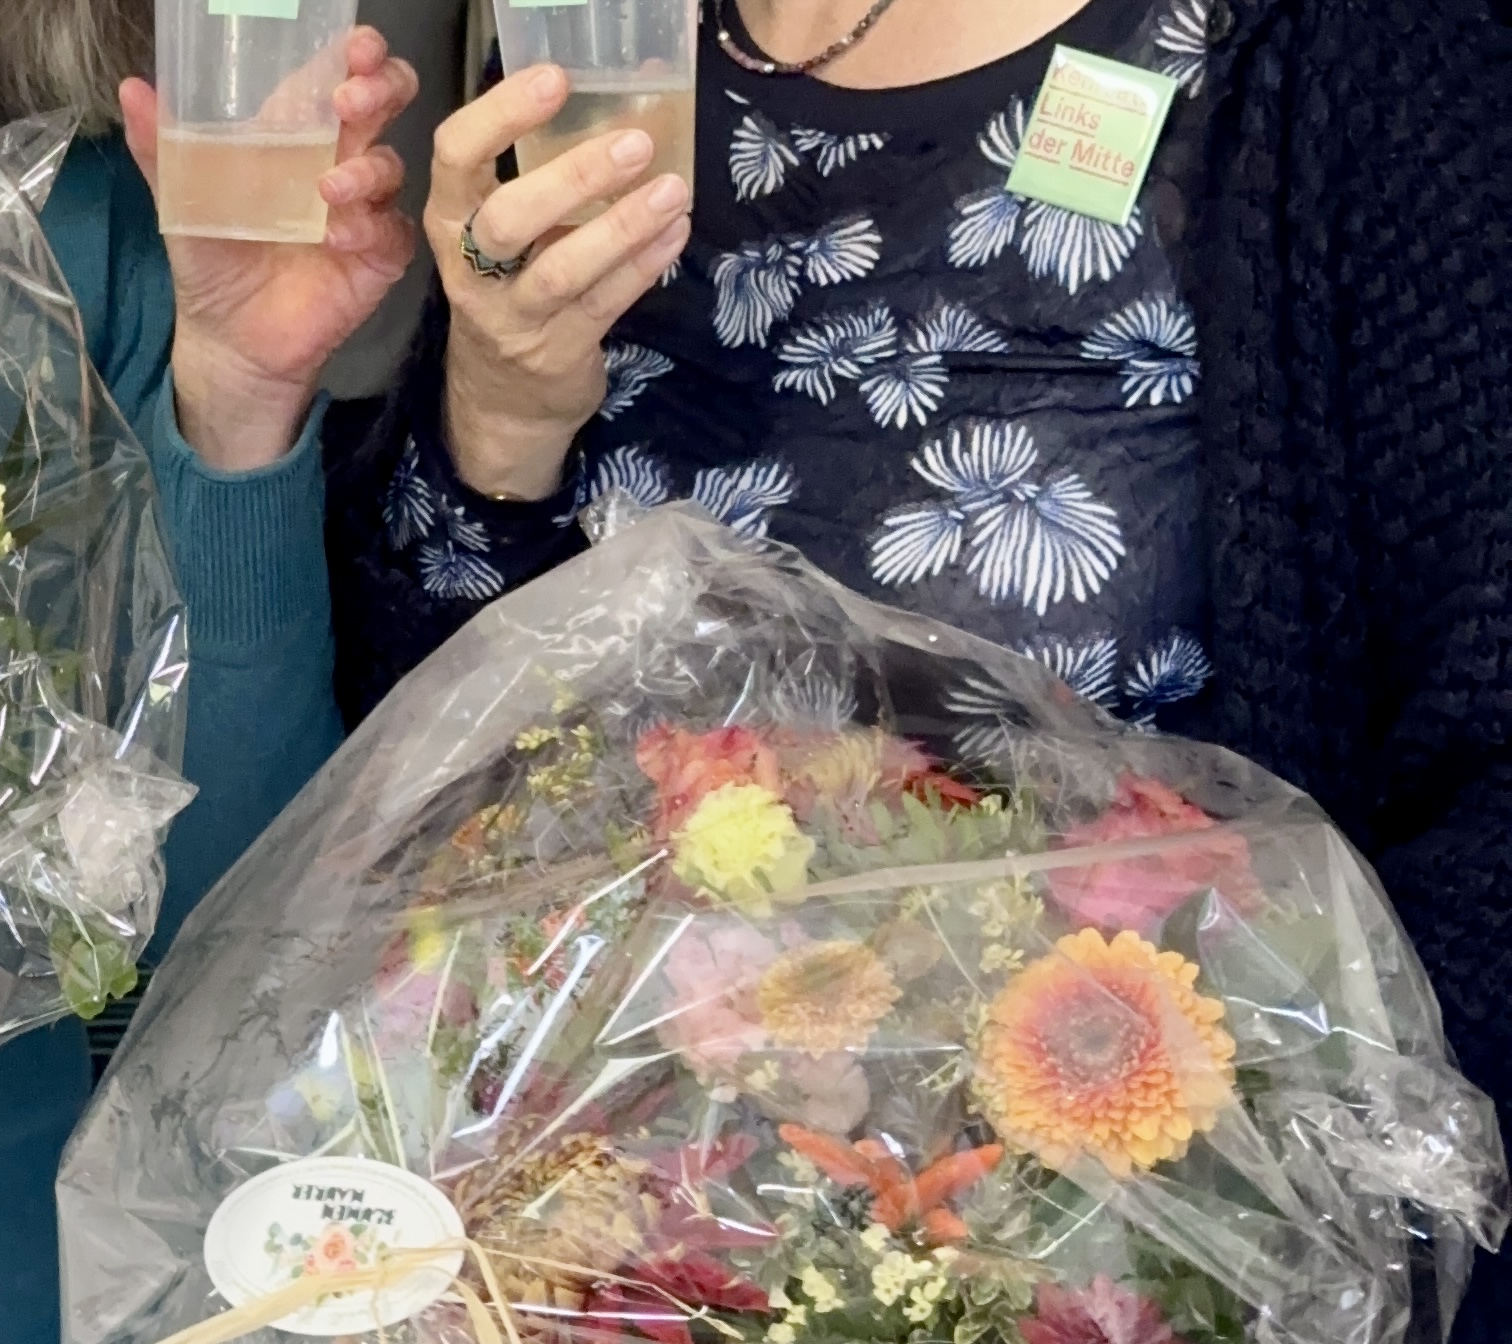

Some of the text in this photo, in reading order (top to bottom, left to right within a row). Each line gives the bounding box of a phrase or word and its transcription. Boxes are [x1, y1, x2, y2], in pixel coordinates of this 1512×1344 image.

[1039, 91, 1103, 131] Links
[1028, 128, 1136, 178] der Mitte
